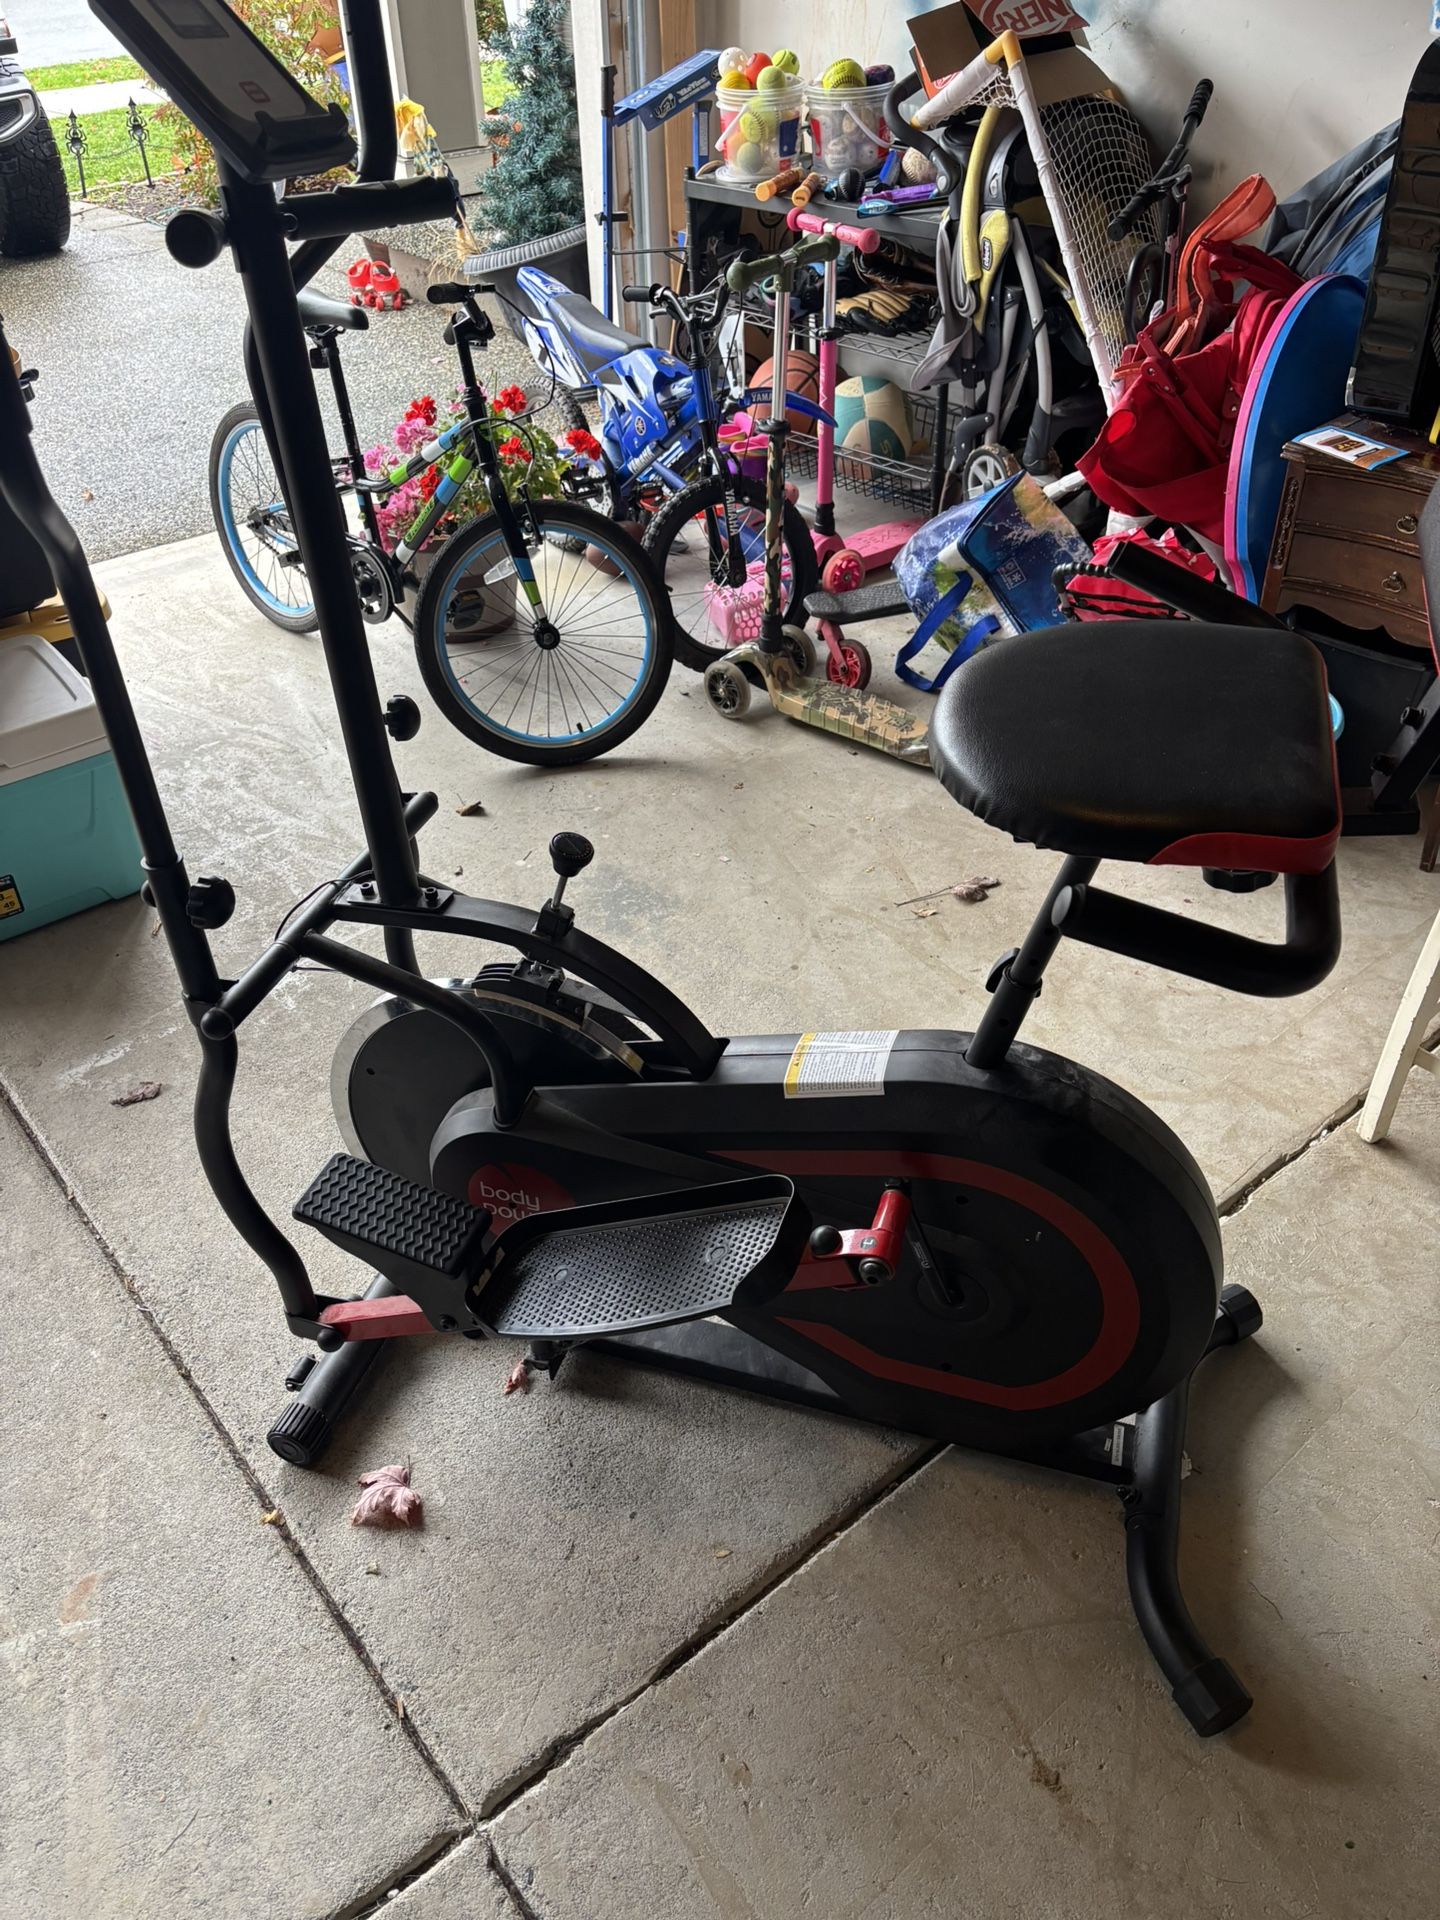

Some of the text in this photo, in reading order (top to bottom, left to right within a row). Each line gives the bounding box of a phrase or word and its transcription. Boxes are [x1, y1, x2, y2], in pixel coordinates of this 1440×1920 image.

[993, 0, 1070, 33] NERF
[725, 488, 739, 537] YAMAHA
[480, 1181, 541, 1212] body
